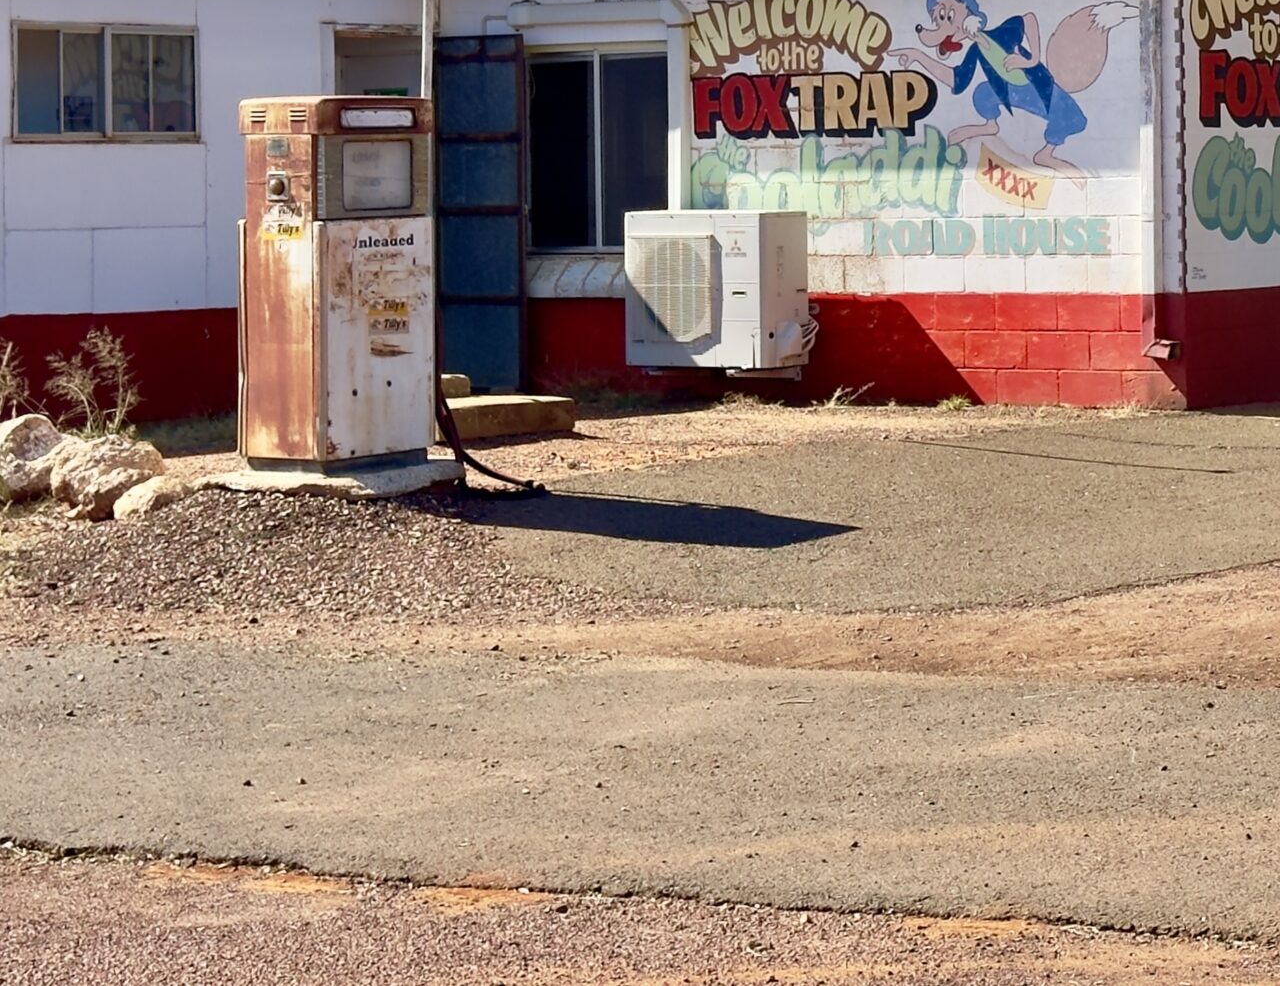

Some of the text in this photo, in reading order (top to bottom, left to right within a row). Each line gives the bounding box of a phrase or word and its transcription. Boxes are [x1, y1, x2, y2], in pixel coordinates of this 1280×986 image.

[1250, 12, 1278, 55] to
[758, 40, 823, 72] to the
[692, 70, 938, 139] FOX TRAP
[714, 133, 750, 171] the
[1229, 132, 1256, 172] the
[982, 157, 1039, 202] XXXX
[863, 213, 1112, 257] ROAD HOUSE
[383, 317, 407, 332] Tilly's
